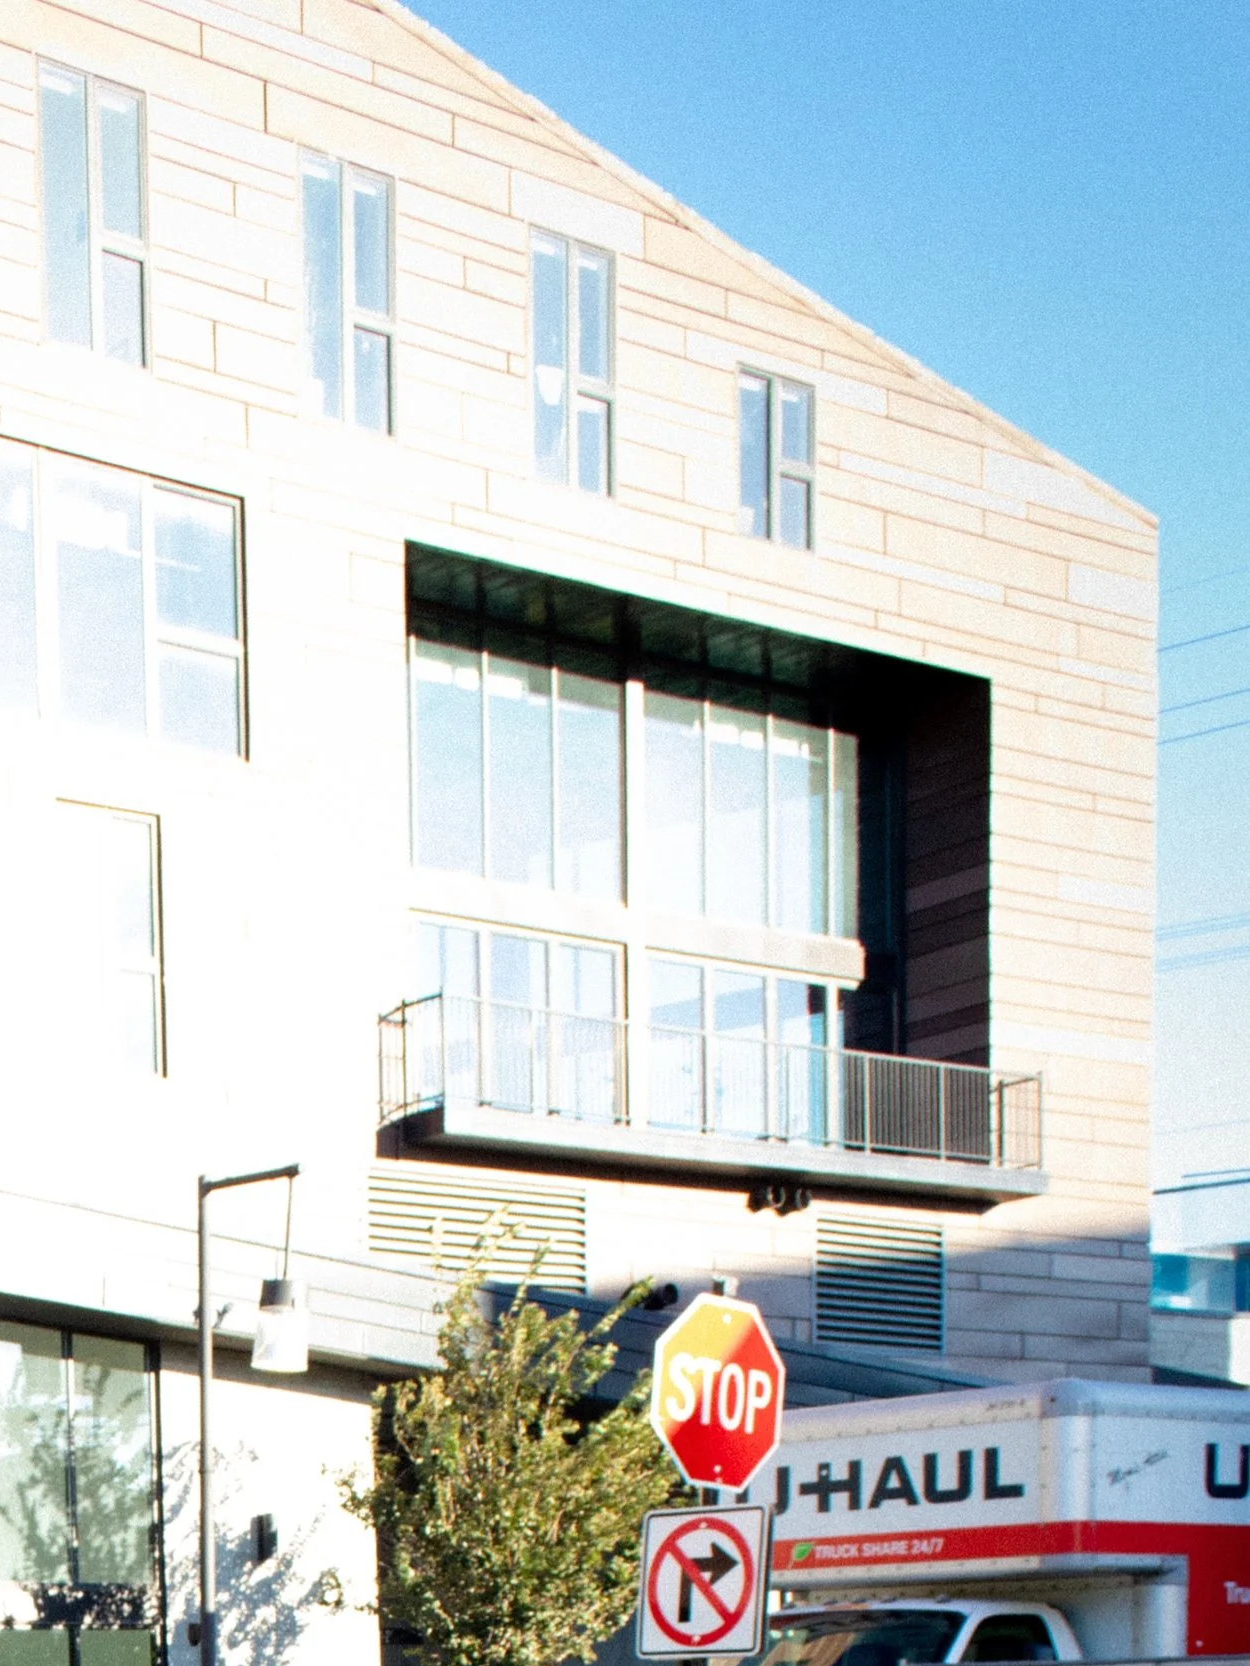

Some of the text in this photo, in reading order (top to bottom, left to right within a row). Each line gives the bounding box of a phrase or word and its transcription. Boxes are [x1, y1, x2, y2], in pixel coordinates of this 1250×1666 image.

[665, 1352, 772, 1435] STOP
[813, 1537, 944, 1560] TRUCK SHARE 24/7
